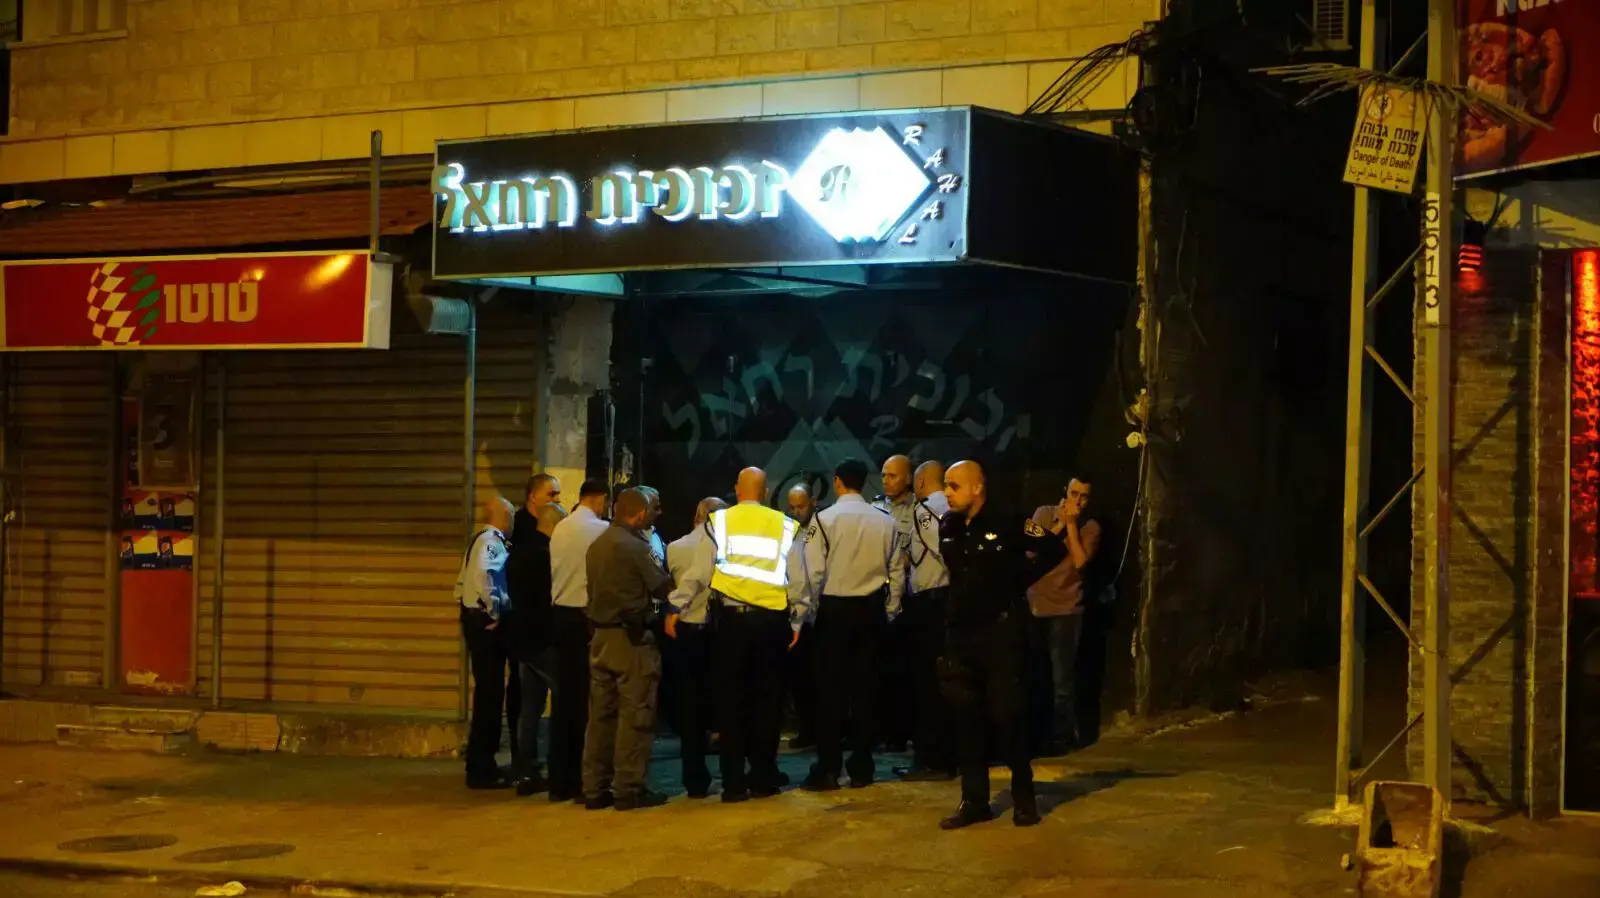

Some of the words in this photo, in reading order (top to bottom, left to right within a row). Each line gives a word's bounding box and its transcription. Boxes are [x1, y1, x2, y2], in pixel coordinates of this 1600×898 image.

[1354, 134, 1384, 150] מוות!
[1394, 127, 1420, 143] מתח
[1388, 141, 1417, 157] סכנת
[1353, 150, 1380, 165] Danger
[1380, 156, 1389, 167] of
[432, 163, 573, 232] רחאל
[586, 160, 788, 224] זכוכית
[163, 281, 259, 324] טוטו
